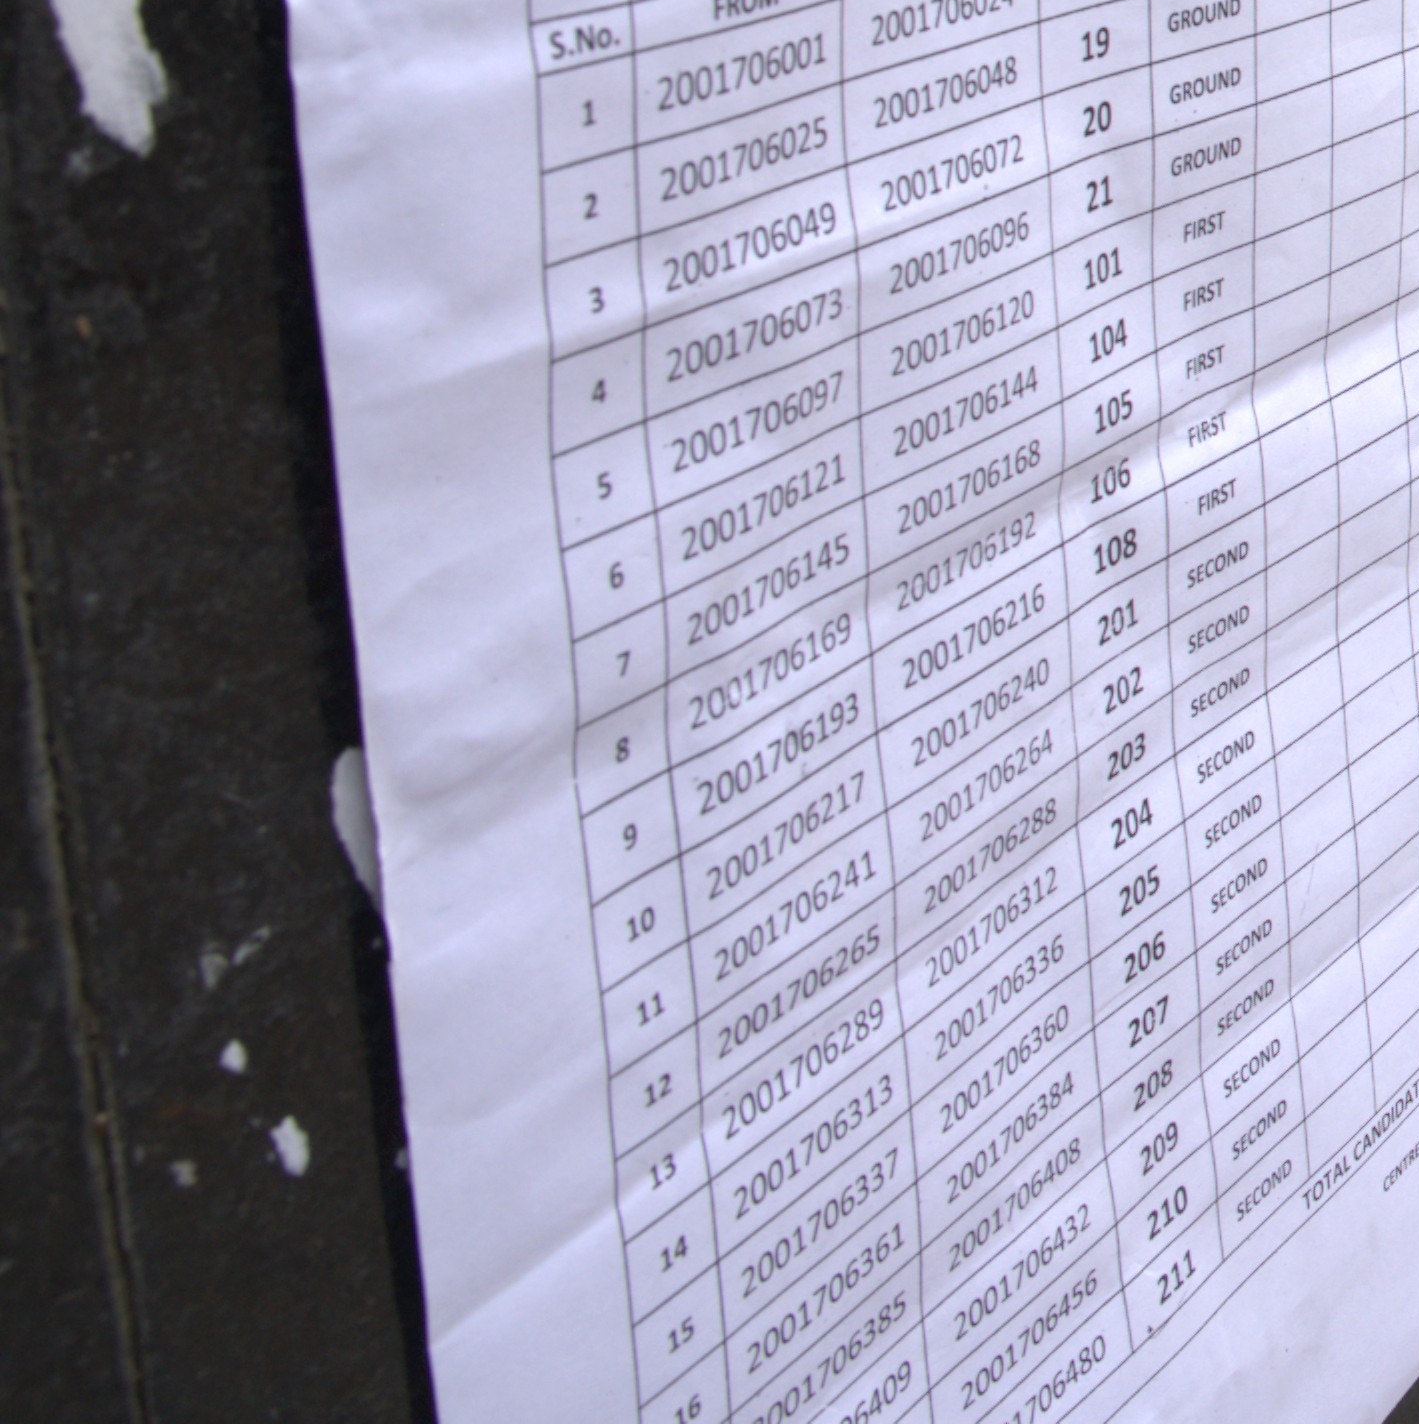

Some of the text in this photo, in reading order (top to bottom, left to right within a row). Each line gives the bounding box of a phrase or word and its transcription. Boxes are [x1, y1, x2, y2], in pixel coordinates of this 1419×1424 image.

[549, 25, 620, 60] S.No.
[583, 100, 596, 127] 1
[658, 32, 826, 112] 2001706001
[589, 286, 605, 314] 3
[664, 202, 836, 292] 2001706049
[881, 134, 1024, 212] 2001706072
[1083, 101, 1112, 138] 20
[1169, 67, 1242, 105] GROUND
[597, 471, 613, 500] 5
[671, 370, 843, 473] 2001706097
[891, 290, 1034, 376] 2001706120
[1084, 247, 1123, 290] 101
[1183, 210, 1226, 243] FIRST
[617, 650, 631, 676] 7
[688, 533, 849, 646] 2001706145
[898, 439, 1041, 534] 2001706168
[1095, 389, 1133, 435] 105
[1186, 344, 1225, 379] FIRST
[623, 823, 638, 851] 9
[697, 692, 859, 816] 2001706193
[902, 583, 1045, 690] 2001706216
[1094, 527, 1138, 575] 108
[1198, 478, 1236, 516] FIRST
[637, 992, 665, 1026] 11
[715, 851, 876, 982] 2001706241
[920, 728, 1053, 842] 2001706264
[1103, 666, 1144, 715] 202
[1188, 605, 1250, 654] SECOND
[649, 1152, 676, 1190] 13
[721, 998, 884, 1140] 2001706289
[926, 866, 1058, 988] 2001706312
[1111, 797, 1153, 850] 204
[1197, 730, 1255, 784] SECOND
[668, 1316, 694, 1353] 15
[741, 1147, 898, 1298] 2001706337
[940, 1004, 1069, 1133] 2001706360
[1124, 930, 1166, 984] 206
[1211, 857, 1268, 914] SECOND
[949, 1137, 1081, 1272] 2001706408
[1133, 1059, 1173, 1112] 208
[1217, 979, 1274, 1037] SECOND
[1157, 1249, 1196, 1305] 211
[1237, 1159, 1292, 1222] SECOND
[1302, 1155, 1351, 1210] TOTAL
[1383, 1142, 1419, 1192] CENTRE
[961, 1268, 1098, 1411] 2001706456
[1147, 1185, 1188, 1241] 210
[1232, 1099, 1287, 1161] SECOND
